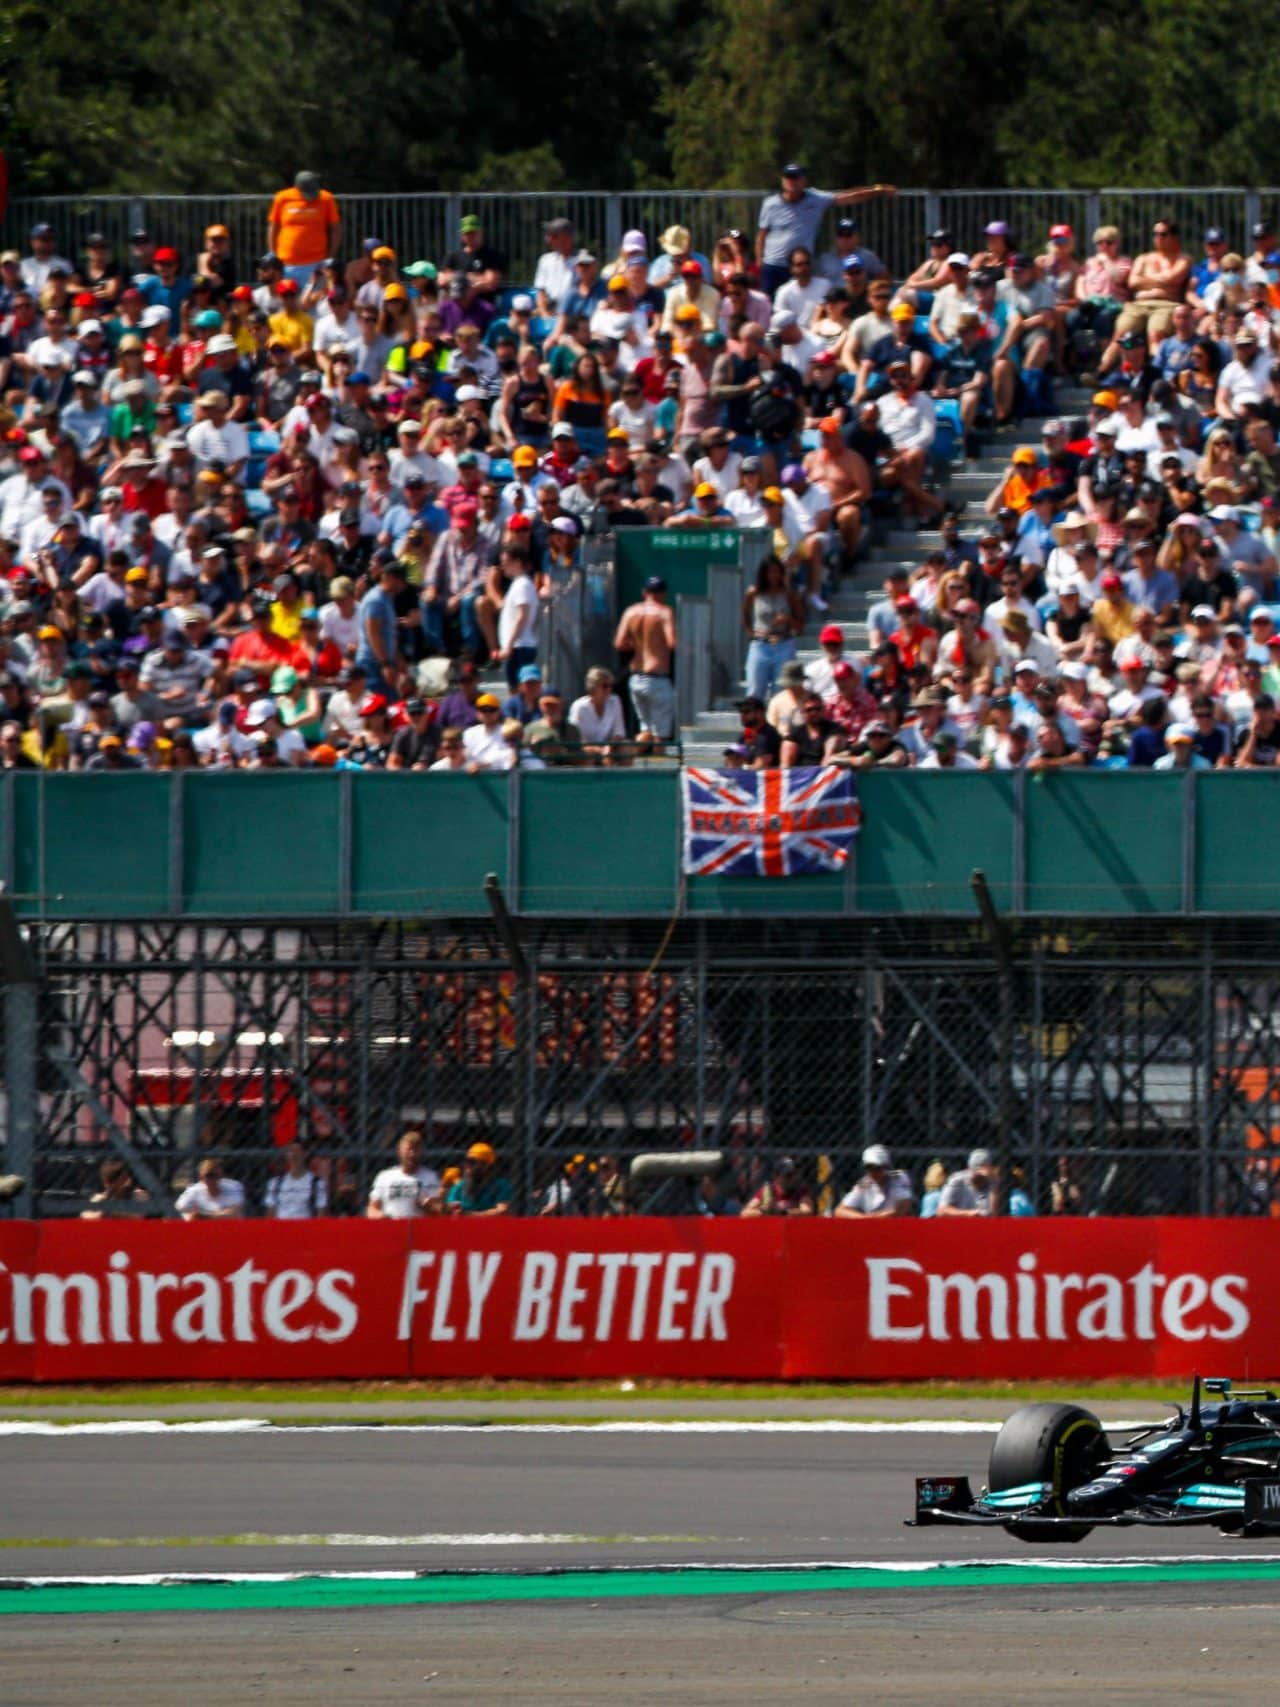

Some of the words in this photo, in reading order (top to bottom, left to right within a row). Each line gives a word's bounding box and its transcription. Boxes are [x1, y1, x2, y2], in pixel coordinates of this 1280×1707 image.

[0, 1250, 358, 1345] mirates
[398, 1251, 502, 1341] FLY
[514, 1251, 735, 1341] BETTER
[865, 1253, 1249, 1342] Emirates
